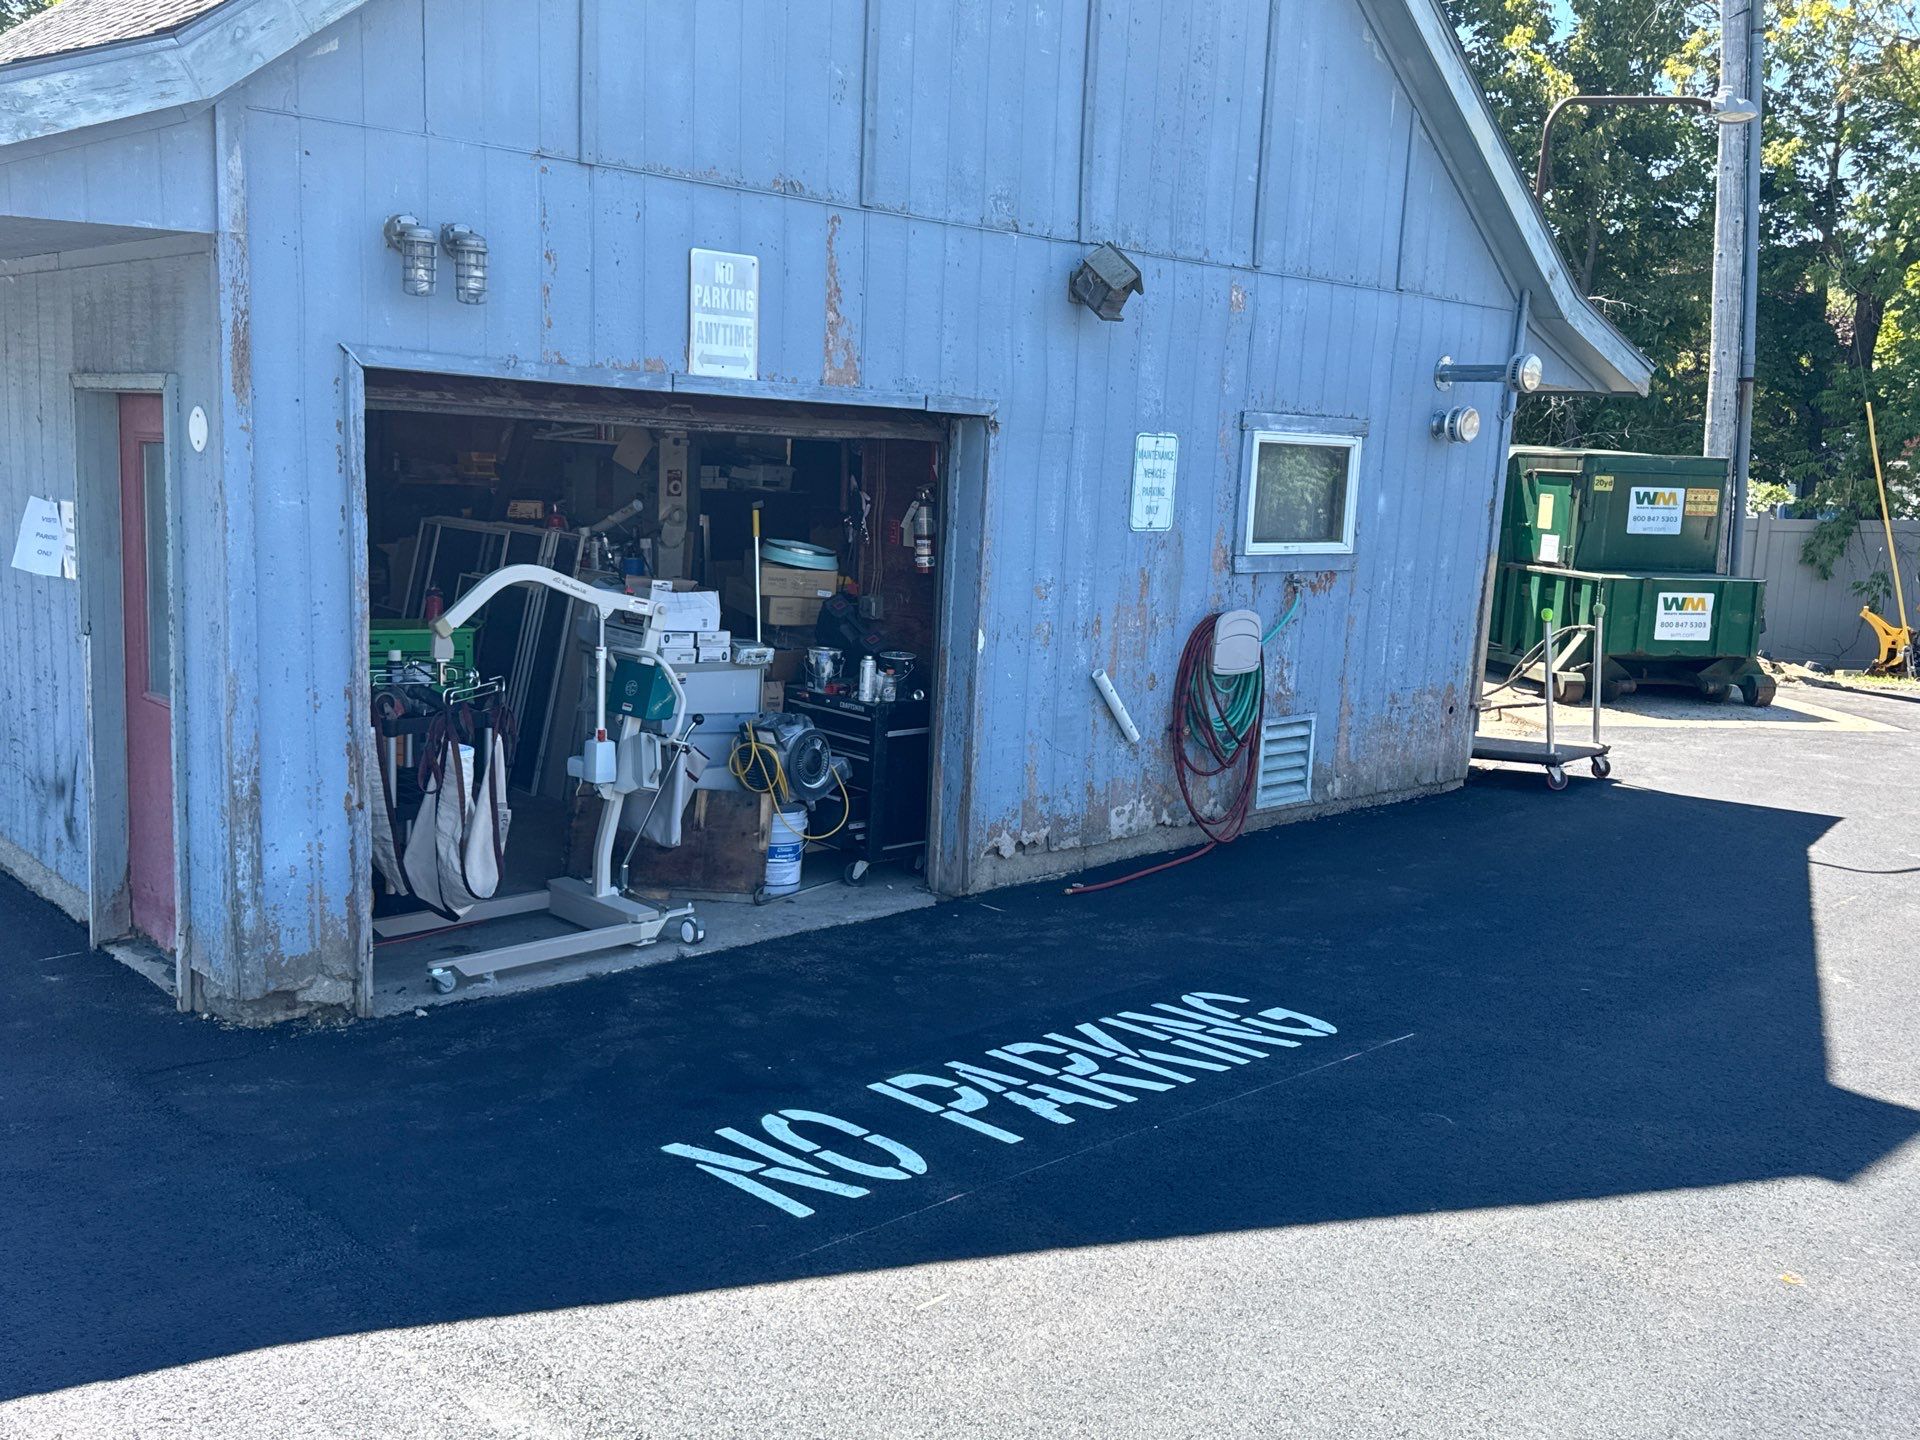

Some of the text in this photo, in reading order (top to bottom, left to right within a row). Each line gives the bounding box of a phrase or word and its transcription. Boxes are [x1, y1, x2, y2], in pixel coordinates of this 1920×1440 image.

[714, 261, 734, 285] NO
[694, 284, 755, 313] PARKING
[696, 321, 753, 348] ANYTIME
[1136, 449, 1175, 461] MAINTENANCE
[1143, 467, 1167, 479] VEHICLE
[1595, 479, 1613, 488] 20yd
[1141, 487, 1165, 497] PARKING
[1635, 491, 1678, 505] WM
[1145, 505, 1159, 515] ONLY
[1662, 597, 1706, 611] WM
[866, 992, 1338, 1144] PARKING
[661, 1109, 928, 1218] NO
